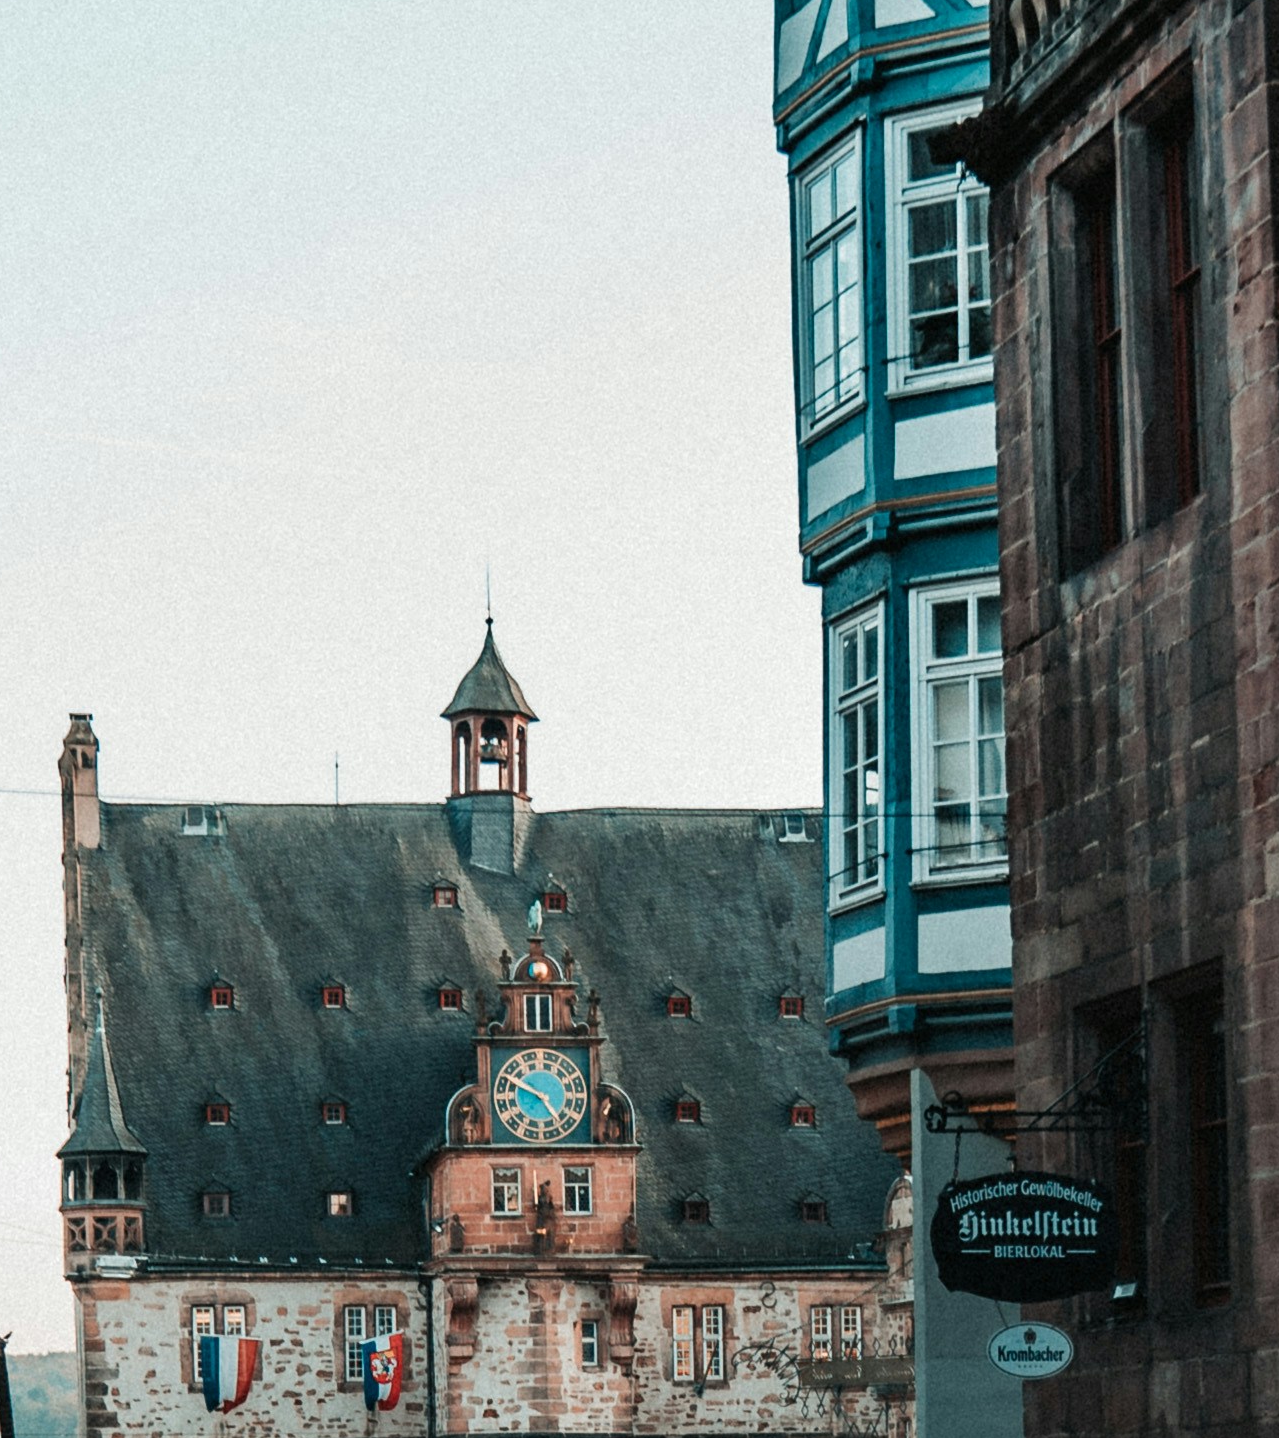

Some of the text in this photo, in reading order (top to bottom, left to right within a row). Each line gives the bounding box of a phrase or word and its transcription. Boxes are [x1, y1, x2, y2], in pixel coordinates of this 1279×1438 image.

[950, 1179, 1103, 1213] Historischer Gewölbekeller
[994, 1245, 1066, 1258] BIERLOKAL
[998, 1346, 1065, 1362] Krombacher
